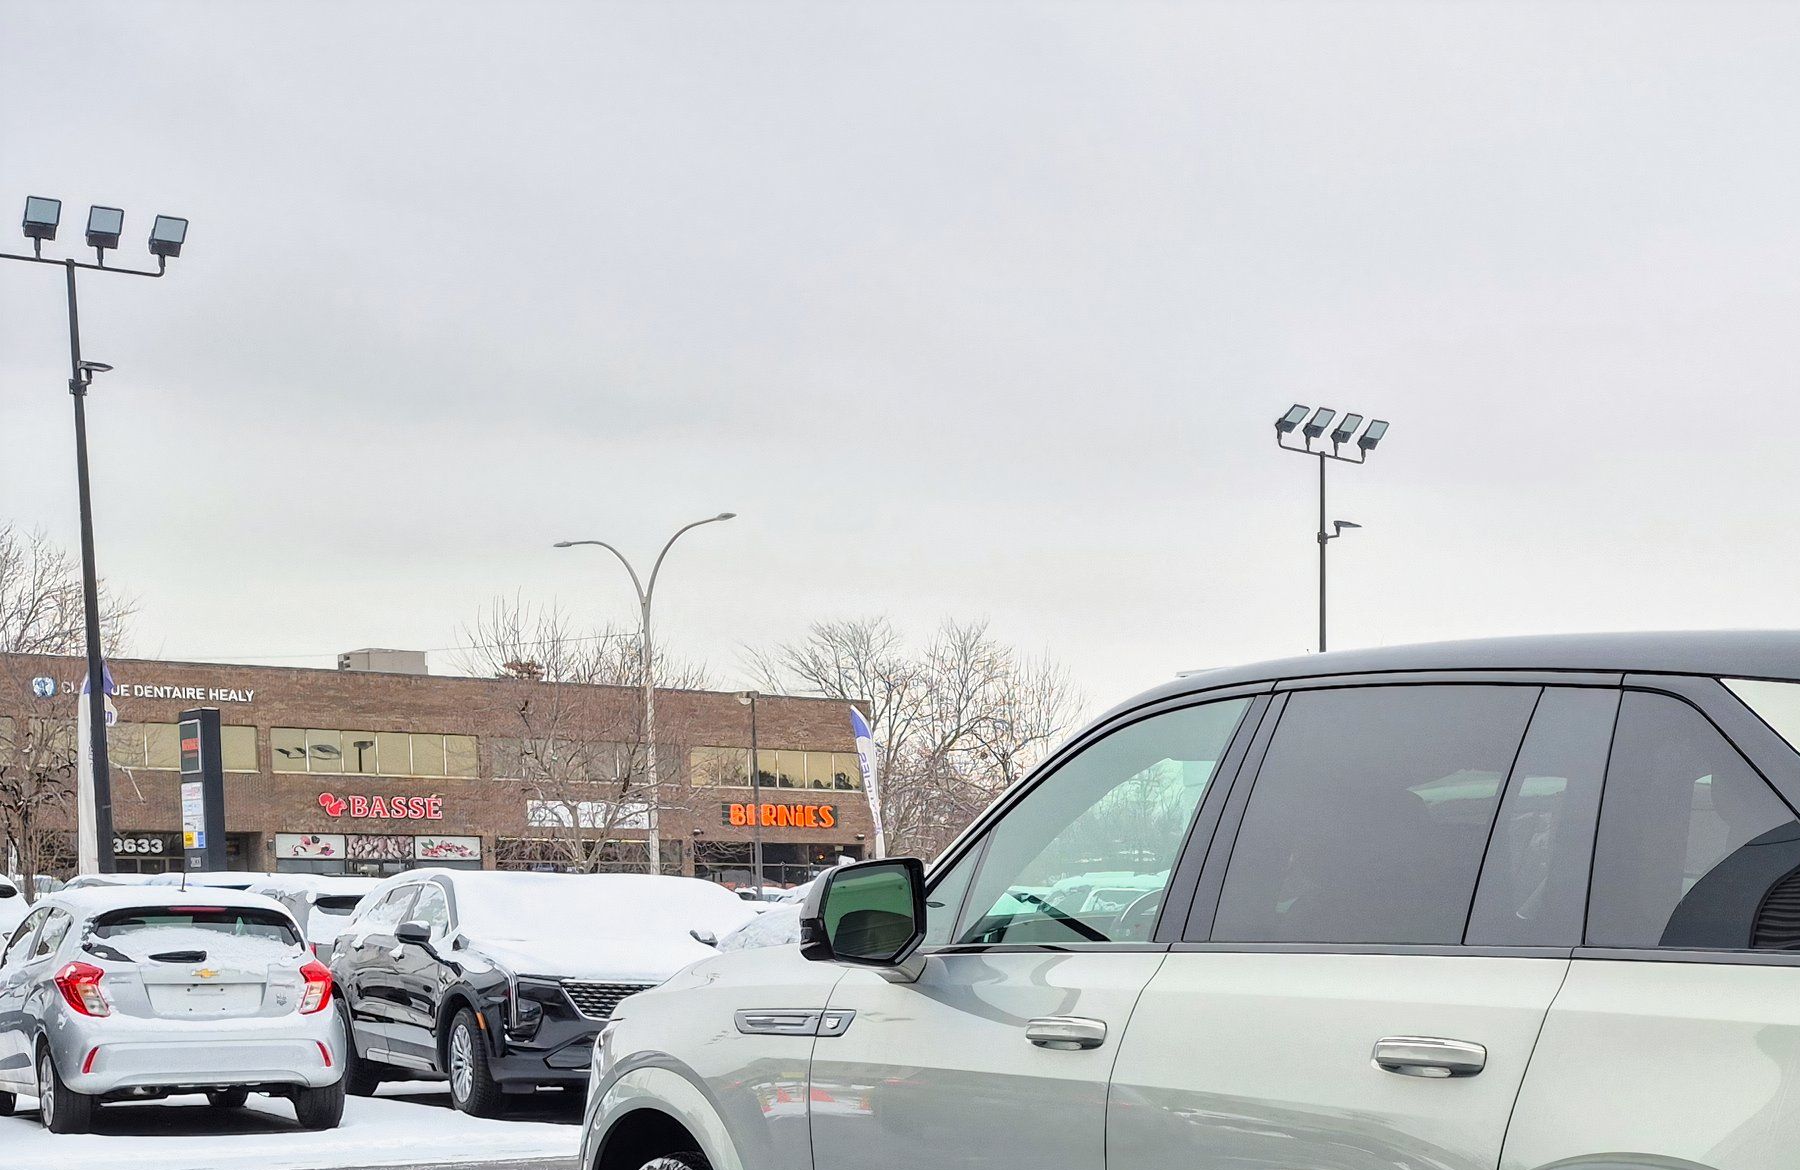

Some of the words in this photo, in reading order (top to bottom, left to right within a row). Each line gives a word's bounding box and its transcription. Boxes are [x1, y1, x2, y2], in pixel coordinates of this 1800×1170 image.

[134, 685, 205, 700] DENTAIRE
[209, 688, 255, 702] HEALY
[112, 838, 163, 854] 3633
